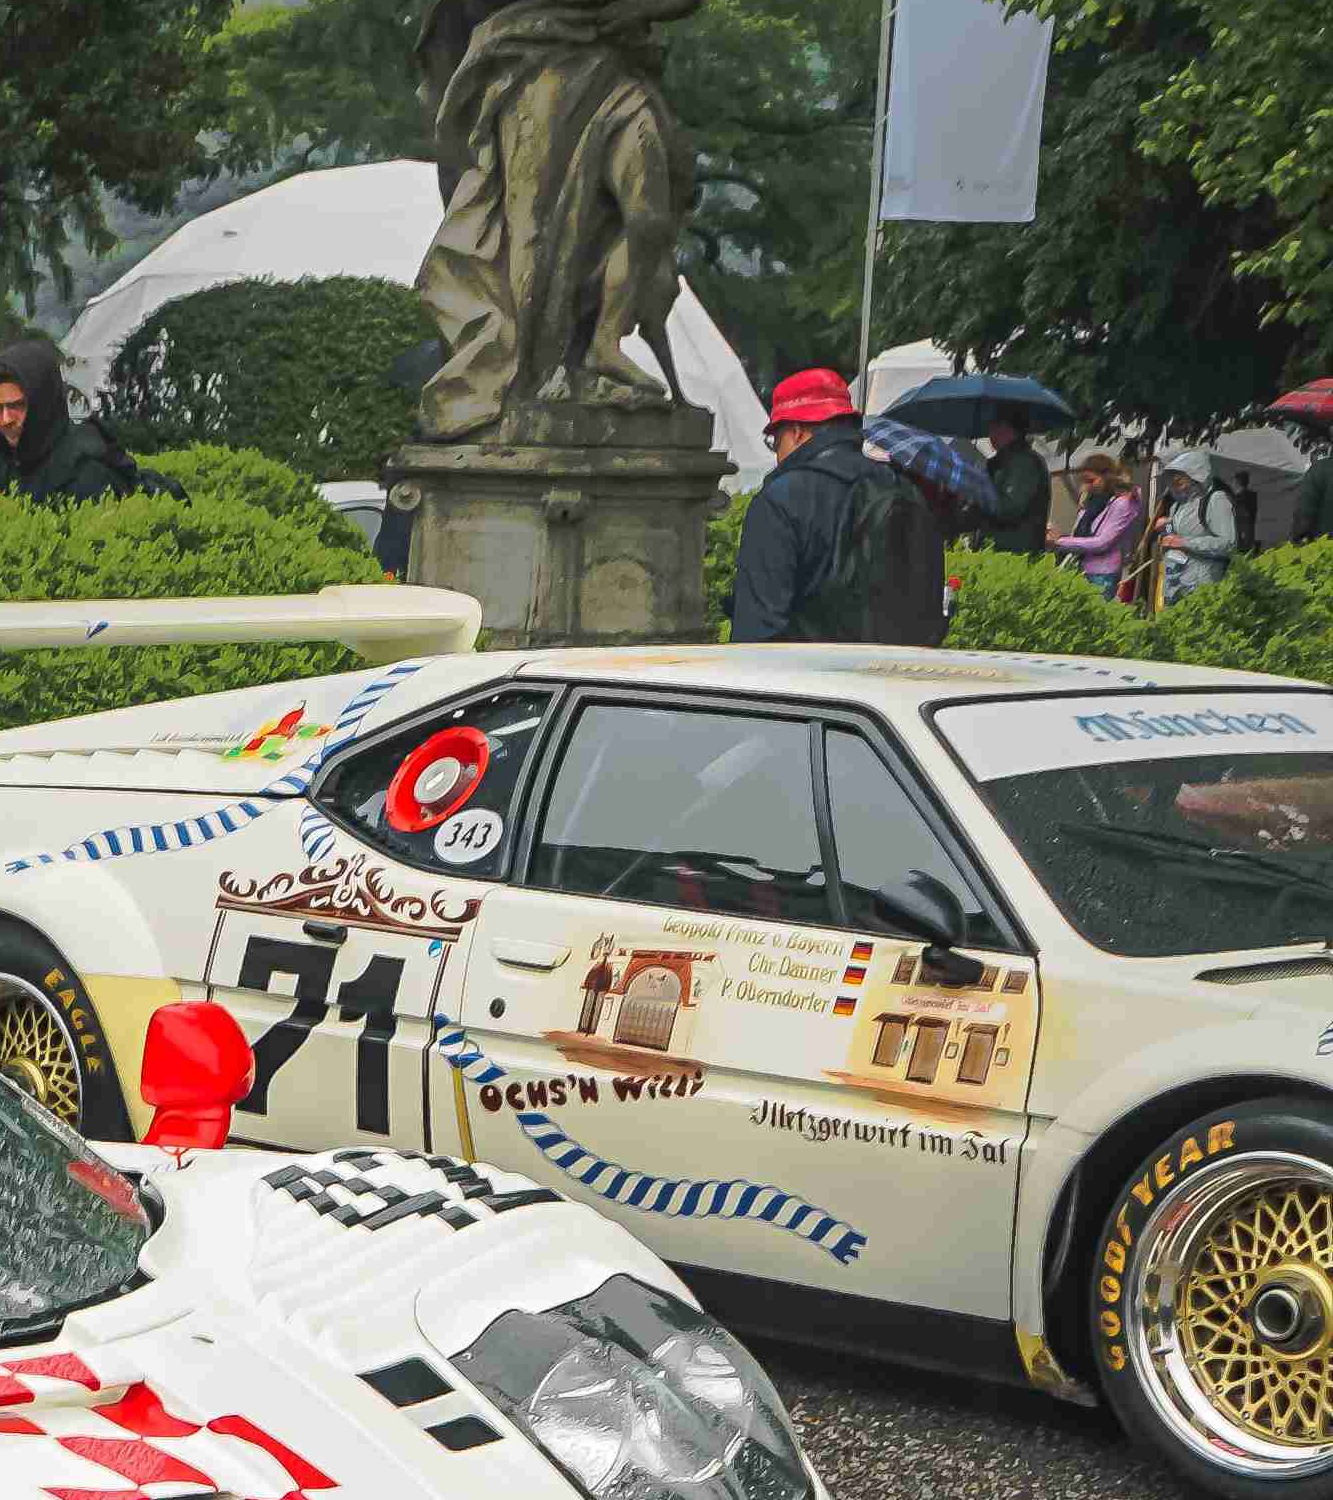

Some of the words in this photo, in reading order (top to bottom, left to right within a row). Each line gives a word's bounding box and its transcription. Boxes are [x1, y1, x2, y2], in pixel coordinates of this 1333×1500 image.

[444, 821, 493, 850] 343
[44, 967, 103, 1074] EAGLE
[235, 934, 406, 1136] 71
[918, 1127, 954, 1157] im
